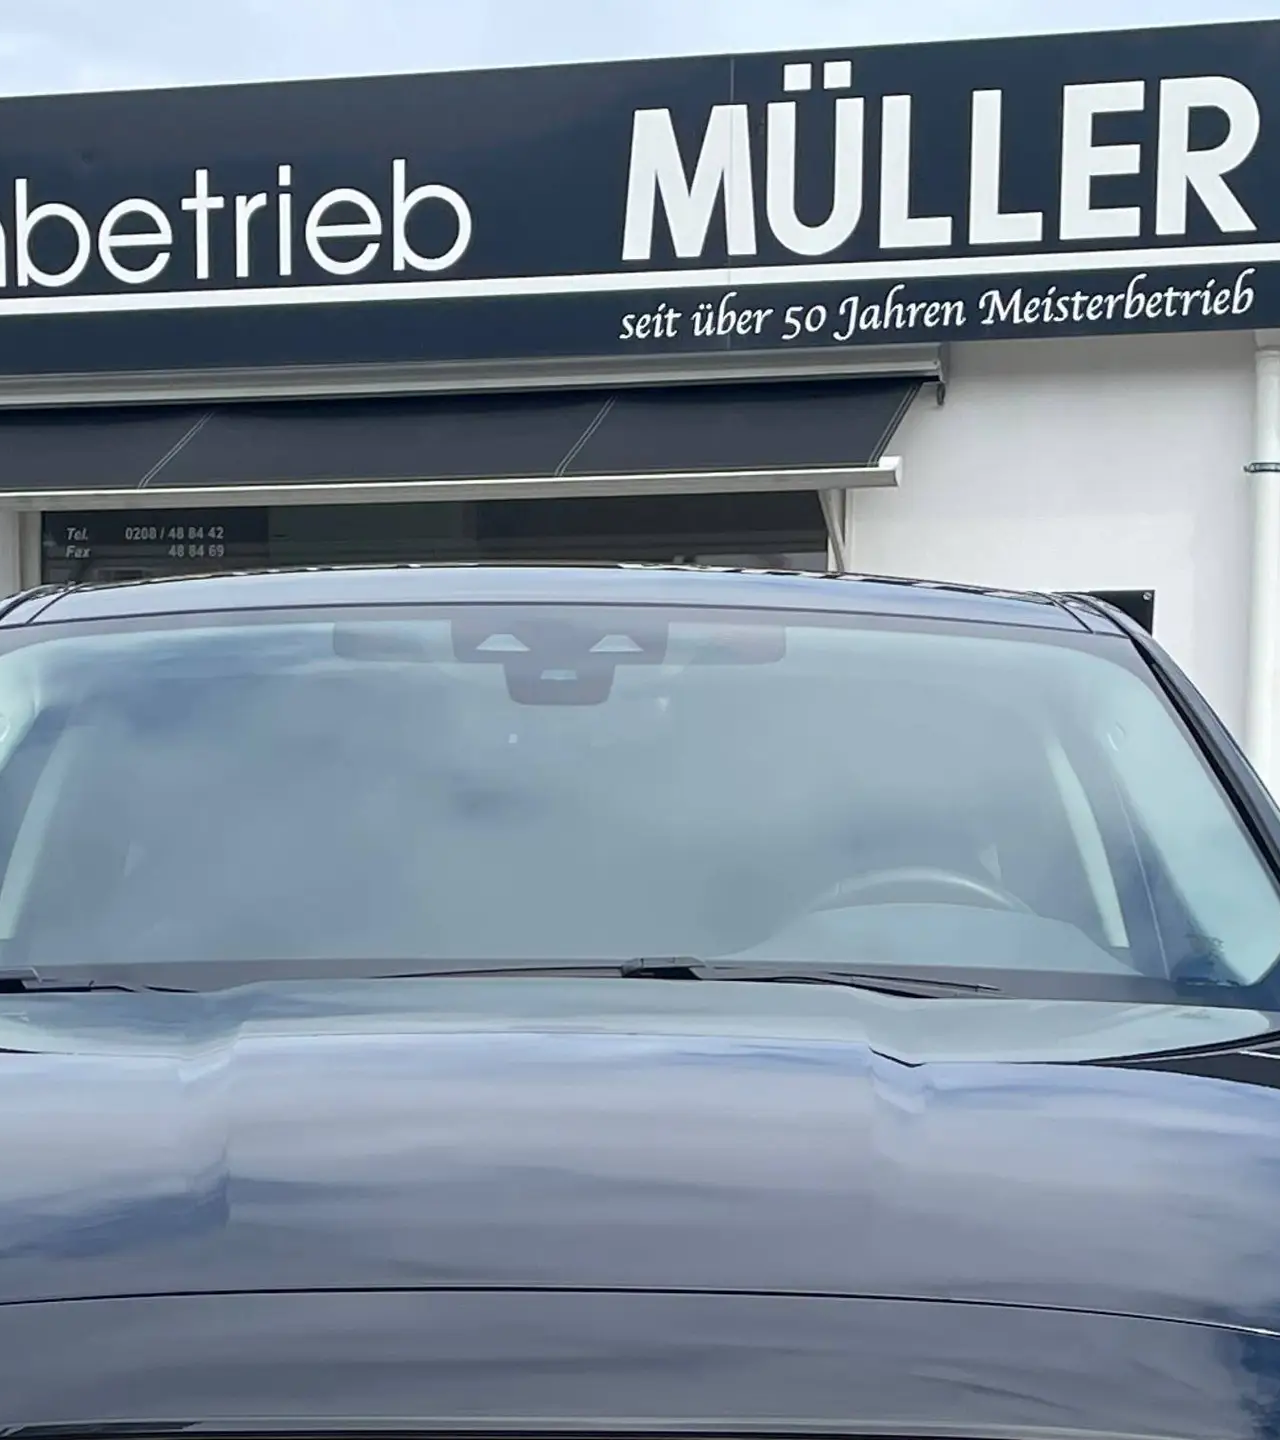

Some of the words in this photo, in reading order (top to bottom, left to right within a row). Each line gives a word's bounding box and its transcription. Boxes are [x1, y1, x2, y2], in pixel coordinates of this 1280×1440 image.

[620, 59, 1261, 262] MÜLLER
[619, 302, 682, 341] seit
[690, 291, 774, 338] über
[781, 304, 827, 341] 50
[832, 284, 967, 342] Jahren
[978, 267, 1256, 326] Meisterbetrieb
[65, 545, 91, 559] Fax
[208, 544, 225, 558] 69
[67, 527, 88, 541] Tel.
[125, 527, 157, 540] 0208
[208, 526, 225, 540] 42
